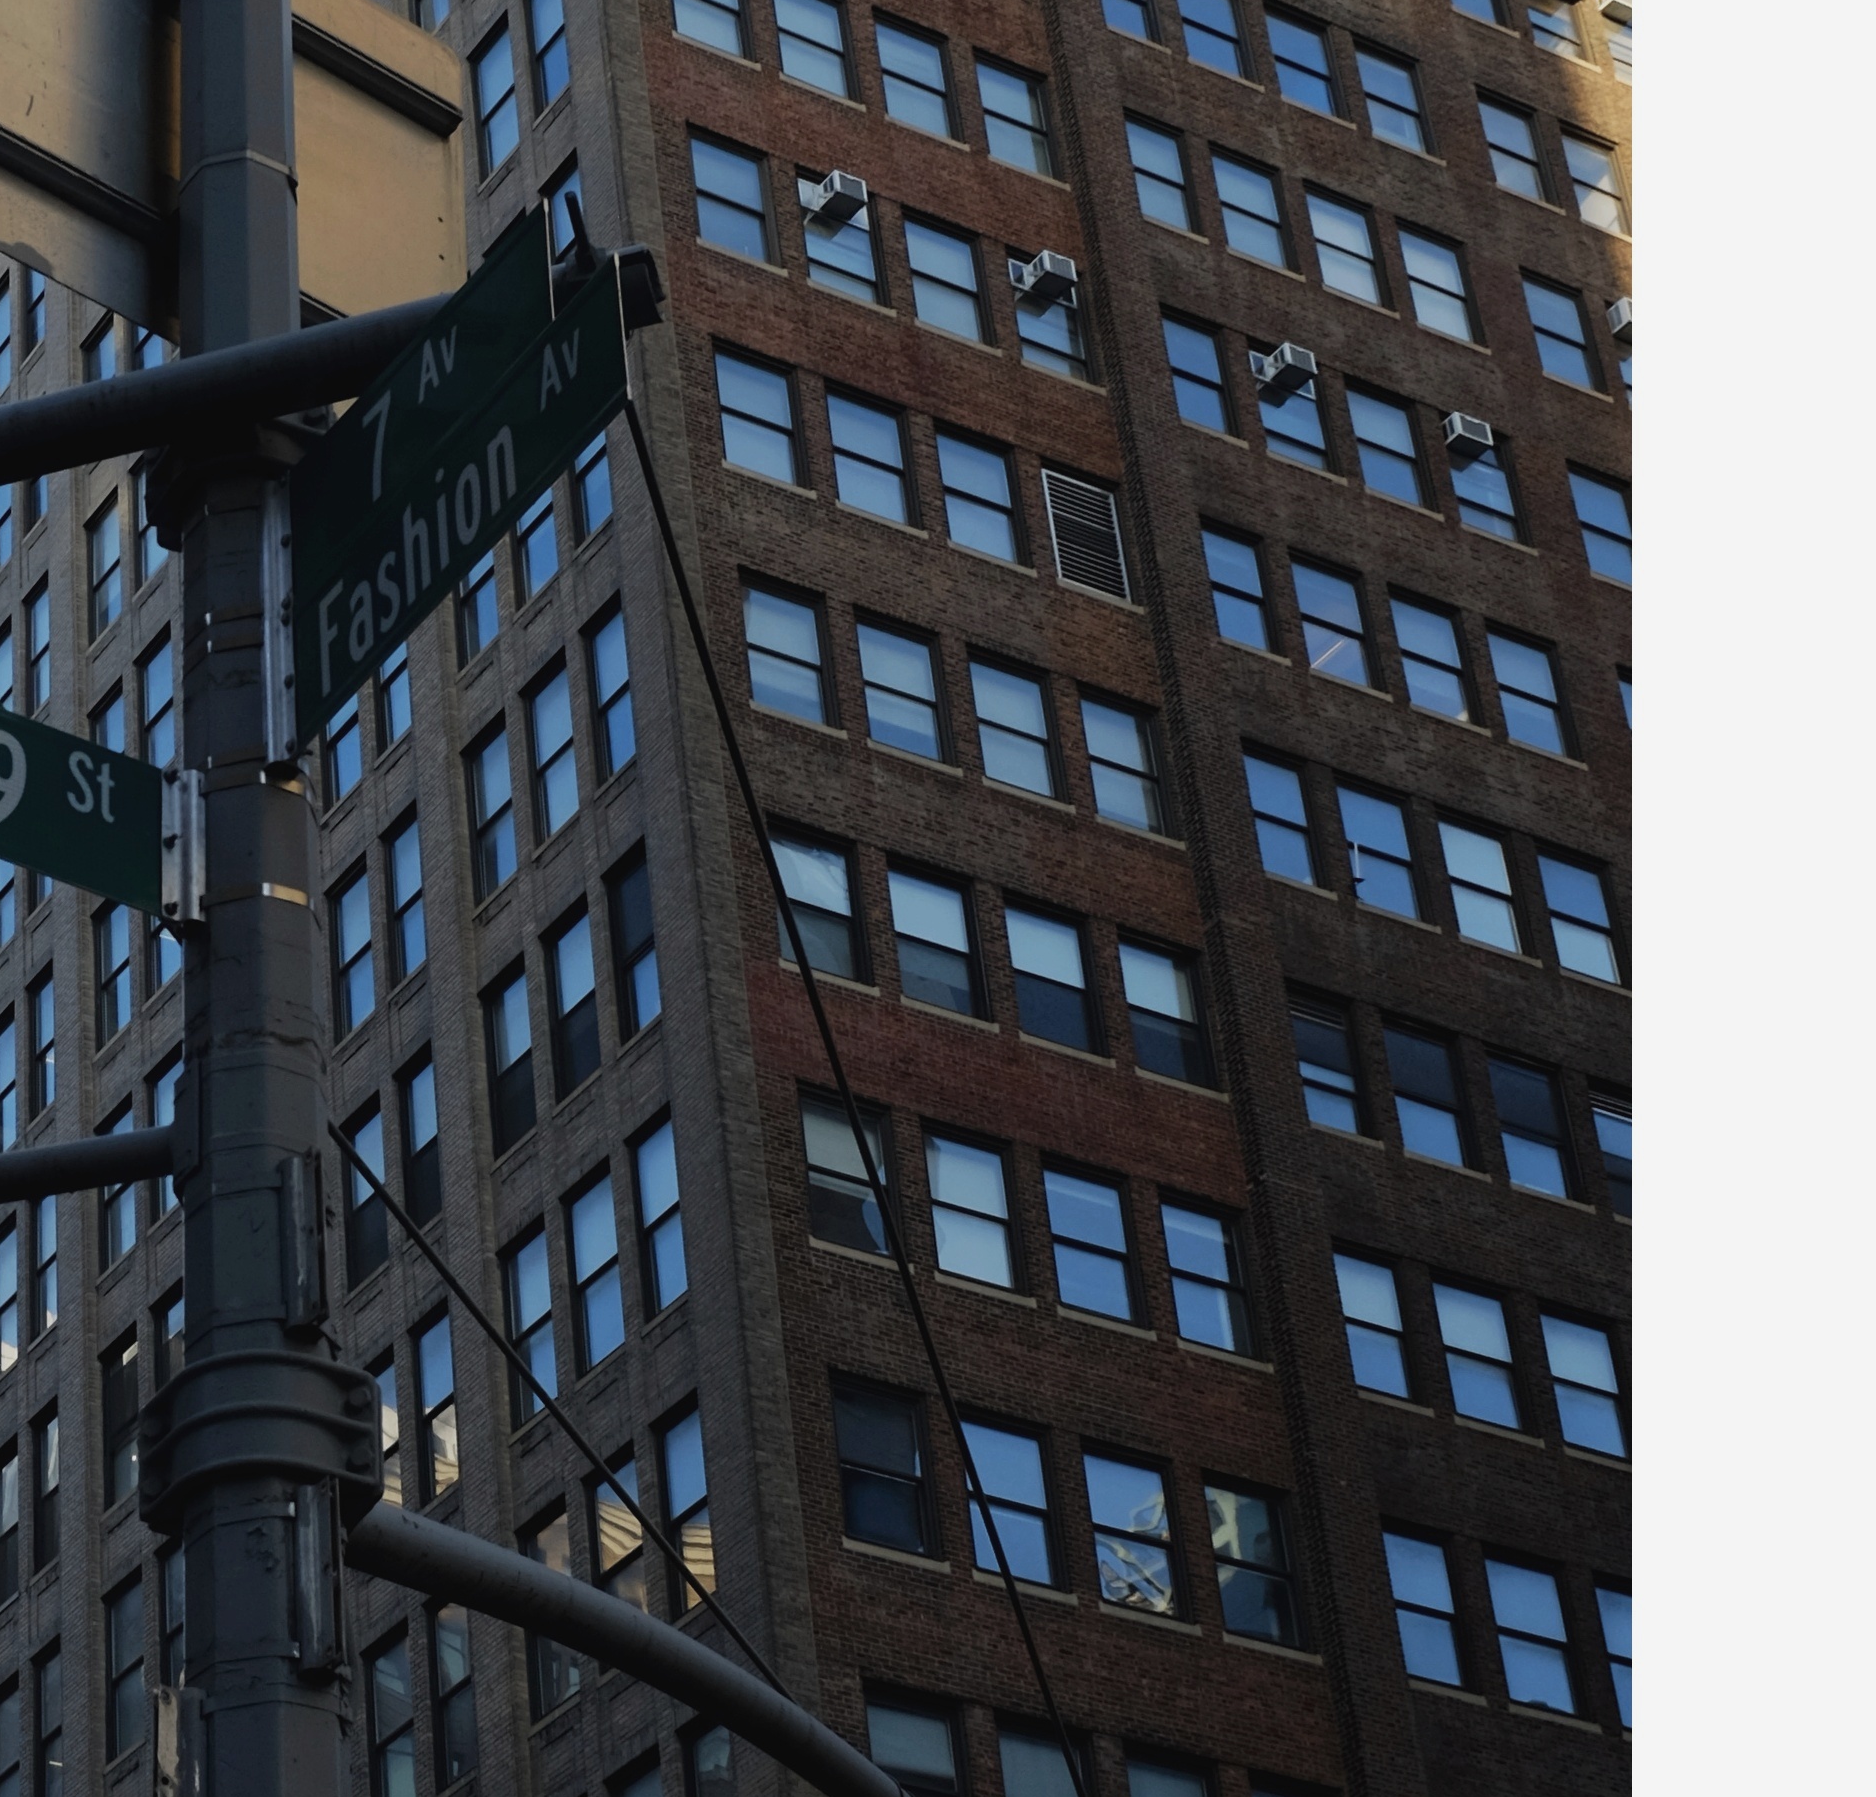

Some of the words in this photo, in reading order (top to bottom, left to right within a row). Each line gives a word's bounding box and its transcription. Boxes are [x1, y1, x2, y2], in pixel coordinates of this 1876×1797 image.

[361, 389, 392, 503] 7
[418, 323, 458, 405] Av
[318, 423, 518, 698] Fashion
[540, 327, 581, 414] Av
[66, 751, 116, 824] St
